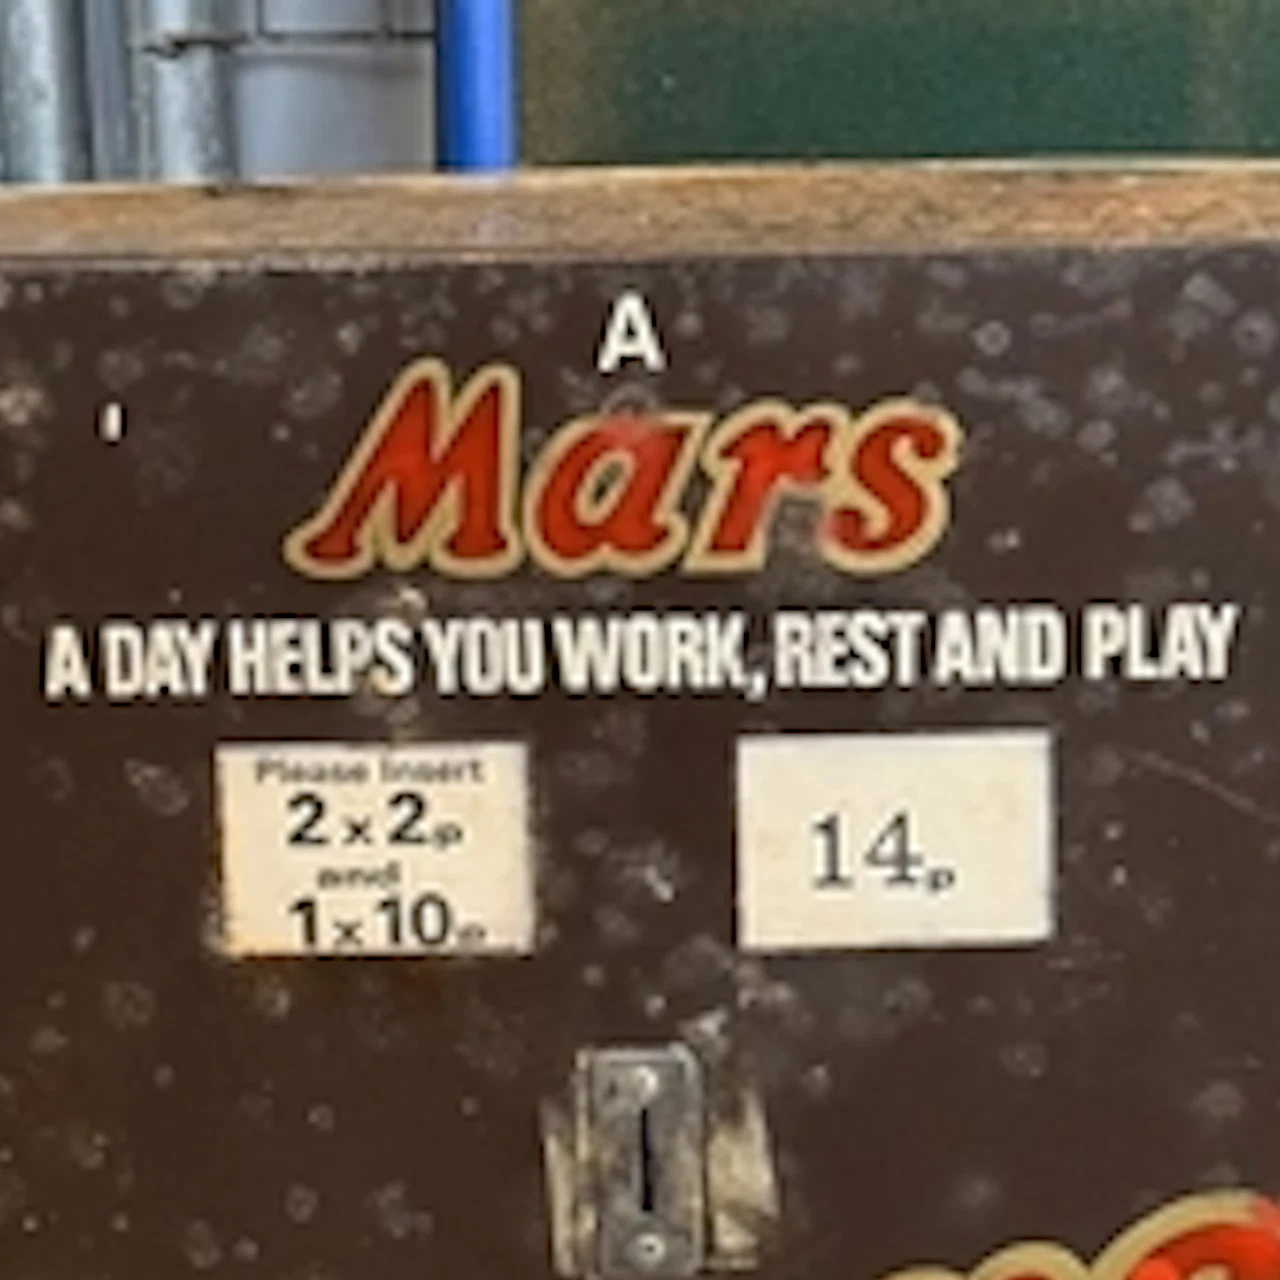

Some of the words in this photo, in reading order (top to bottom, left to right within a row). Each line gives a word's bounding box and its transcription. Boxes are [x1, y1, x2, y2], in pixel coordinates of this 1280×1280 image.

[597, 292, 665, 371] A
[286, 356, 961, 578] Mars
[46, 625, 91, 698] A
[102, 622, 217, 696] DAY
[228, 616, 416, 695] HELPS
[421, 614, 544, 694] YOU
[553, 611, 767, 699] WORK,
[773, 609, 927, 689] REST
[933, 606, 1066, 684] AND
[1082, 602, 1238, 681] PLAY
[255, 758, 370, 783] Please
[286, 791, 328, 844] 2
[811, 808, 956, 893] 14p
[317, 860, 402, 889] and
[287, 896, 317, 946] 1
